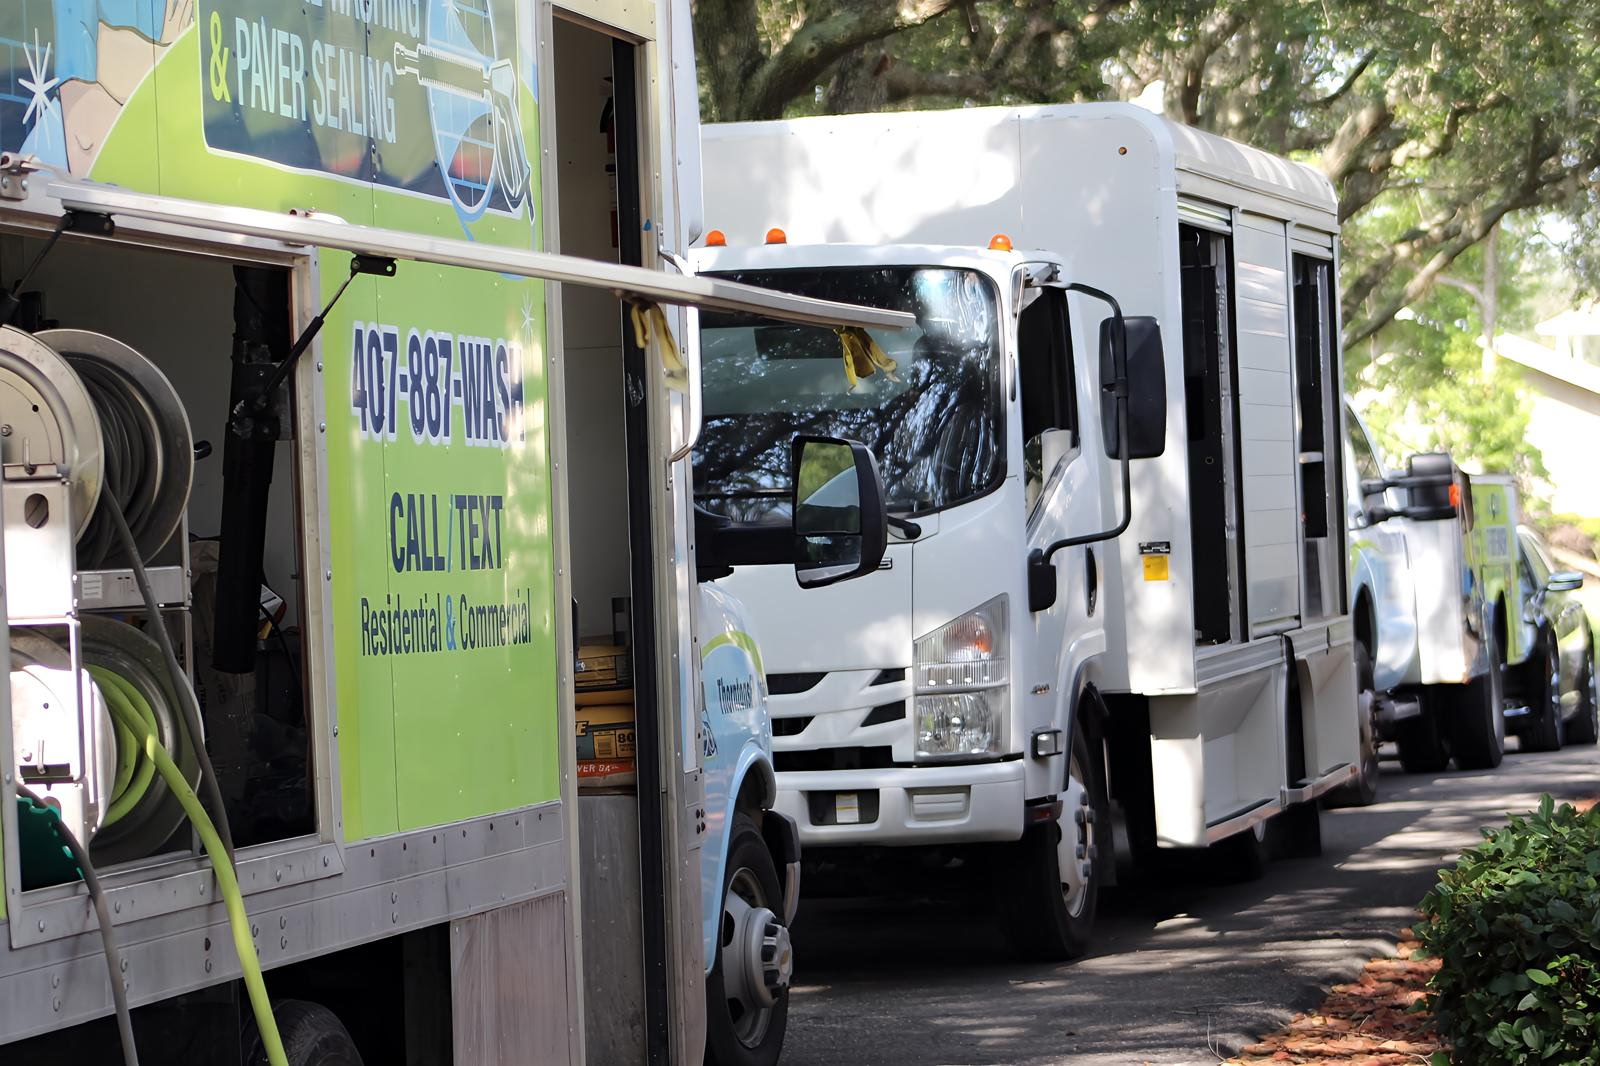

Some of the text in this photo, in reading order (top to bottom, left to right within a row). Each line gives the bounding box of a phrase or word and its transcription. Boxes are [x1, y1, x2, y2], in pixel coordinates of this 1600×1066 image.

[210, 11, 396, 143] & PAVER SEALING
[351, 323, 525, 447] 407-887-WASH
[361, 588, 532, 656] Residential & Commercial
